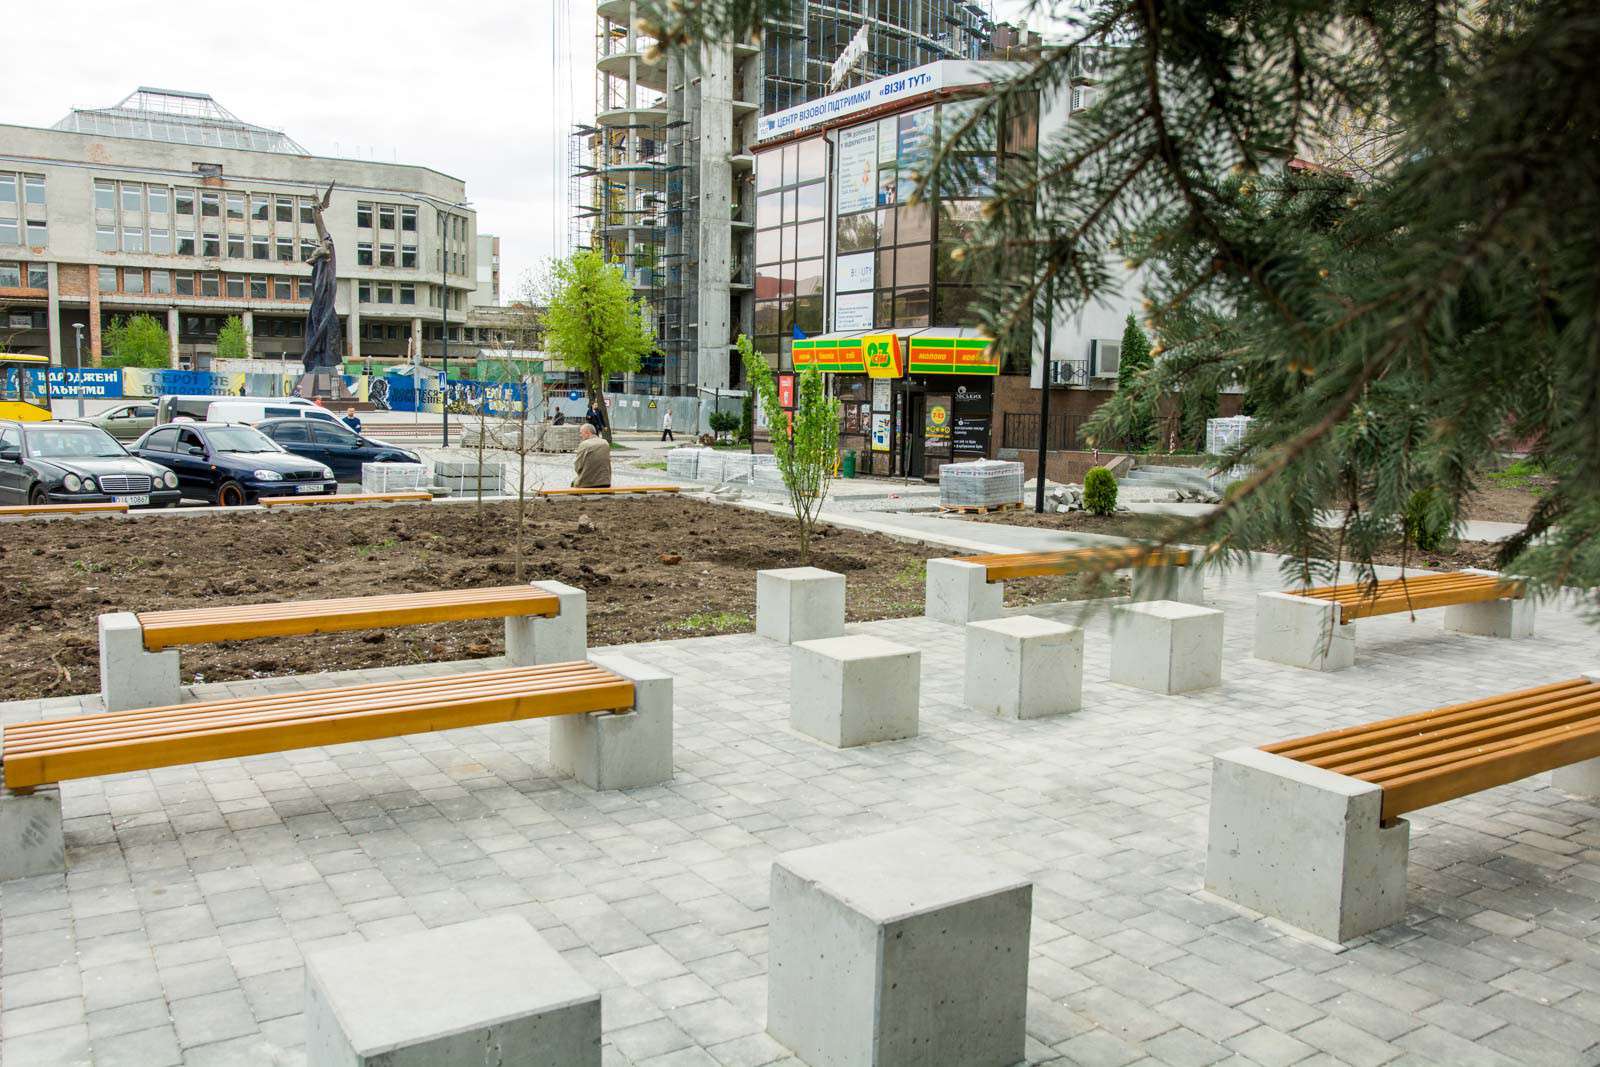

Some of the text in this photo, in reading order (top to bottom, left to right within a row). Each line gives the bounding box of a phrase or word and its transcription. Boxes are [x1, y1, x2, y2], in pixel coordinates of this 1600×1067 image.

[777, 113, 798, 128] ЦЕНТР
[799, 104, 827, 121] ВІЗОВОЇ
[828, 90, 871, 112] ПІДТРИМКИ
[879, 80, 905, 96] «ВІЗИ
[908, 73, 932, 88] ТУТ»
